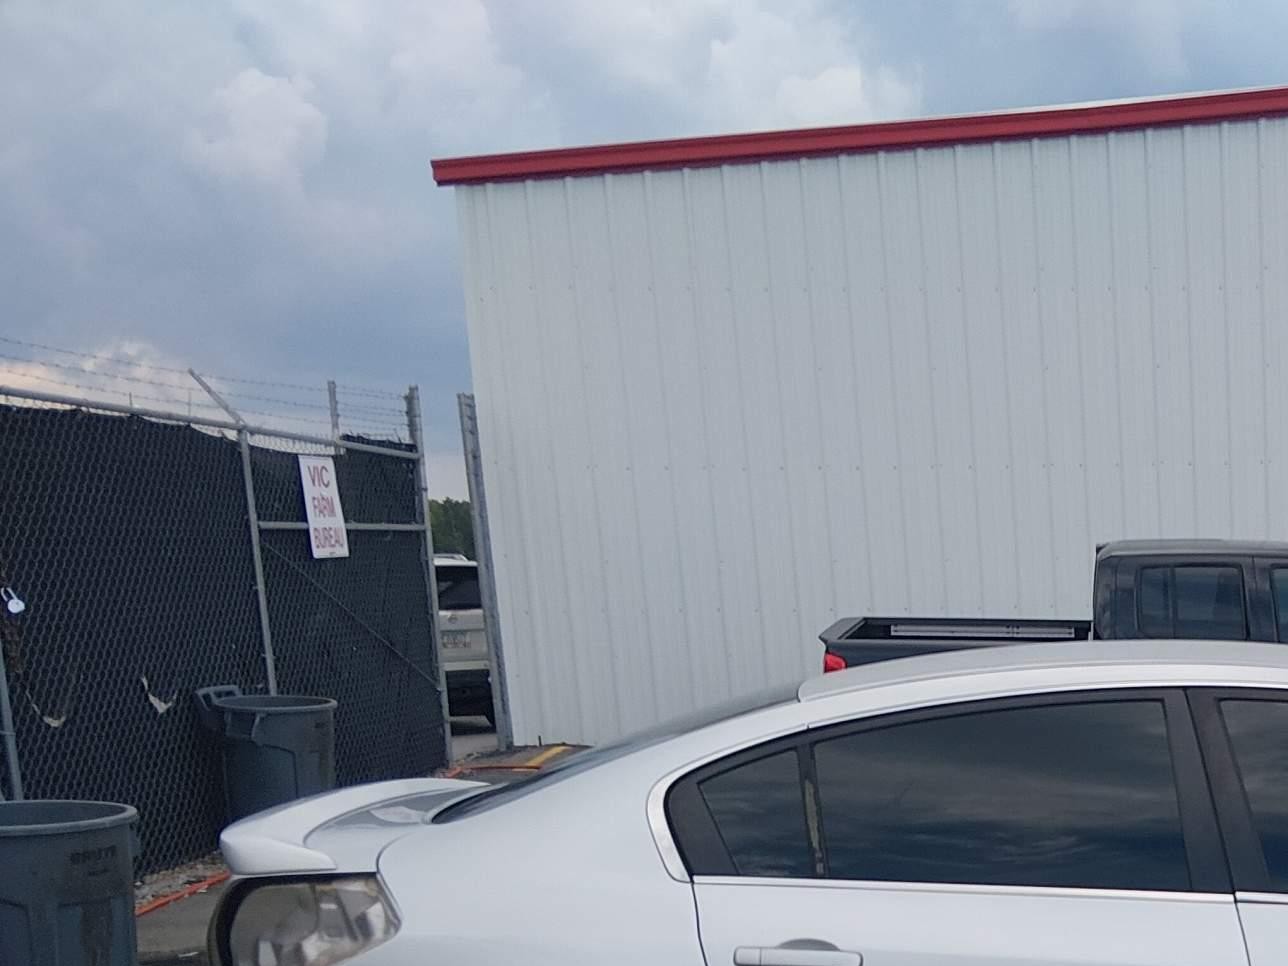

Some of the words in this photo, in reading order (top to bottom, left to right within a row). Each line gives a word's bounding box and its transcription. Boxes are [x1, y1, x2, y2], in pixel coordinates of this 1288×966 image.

[307, 465, 330, 489] VIC
[311, 496, 337, 518] FARM
[313, 527, 345, 549] BUREAU
